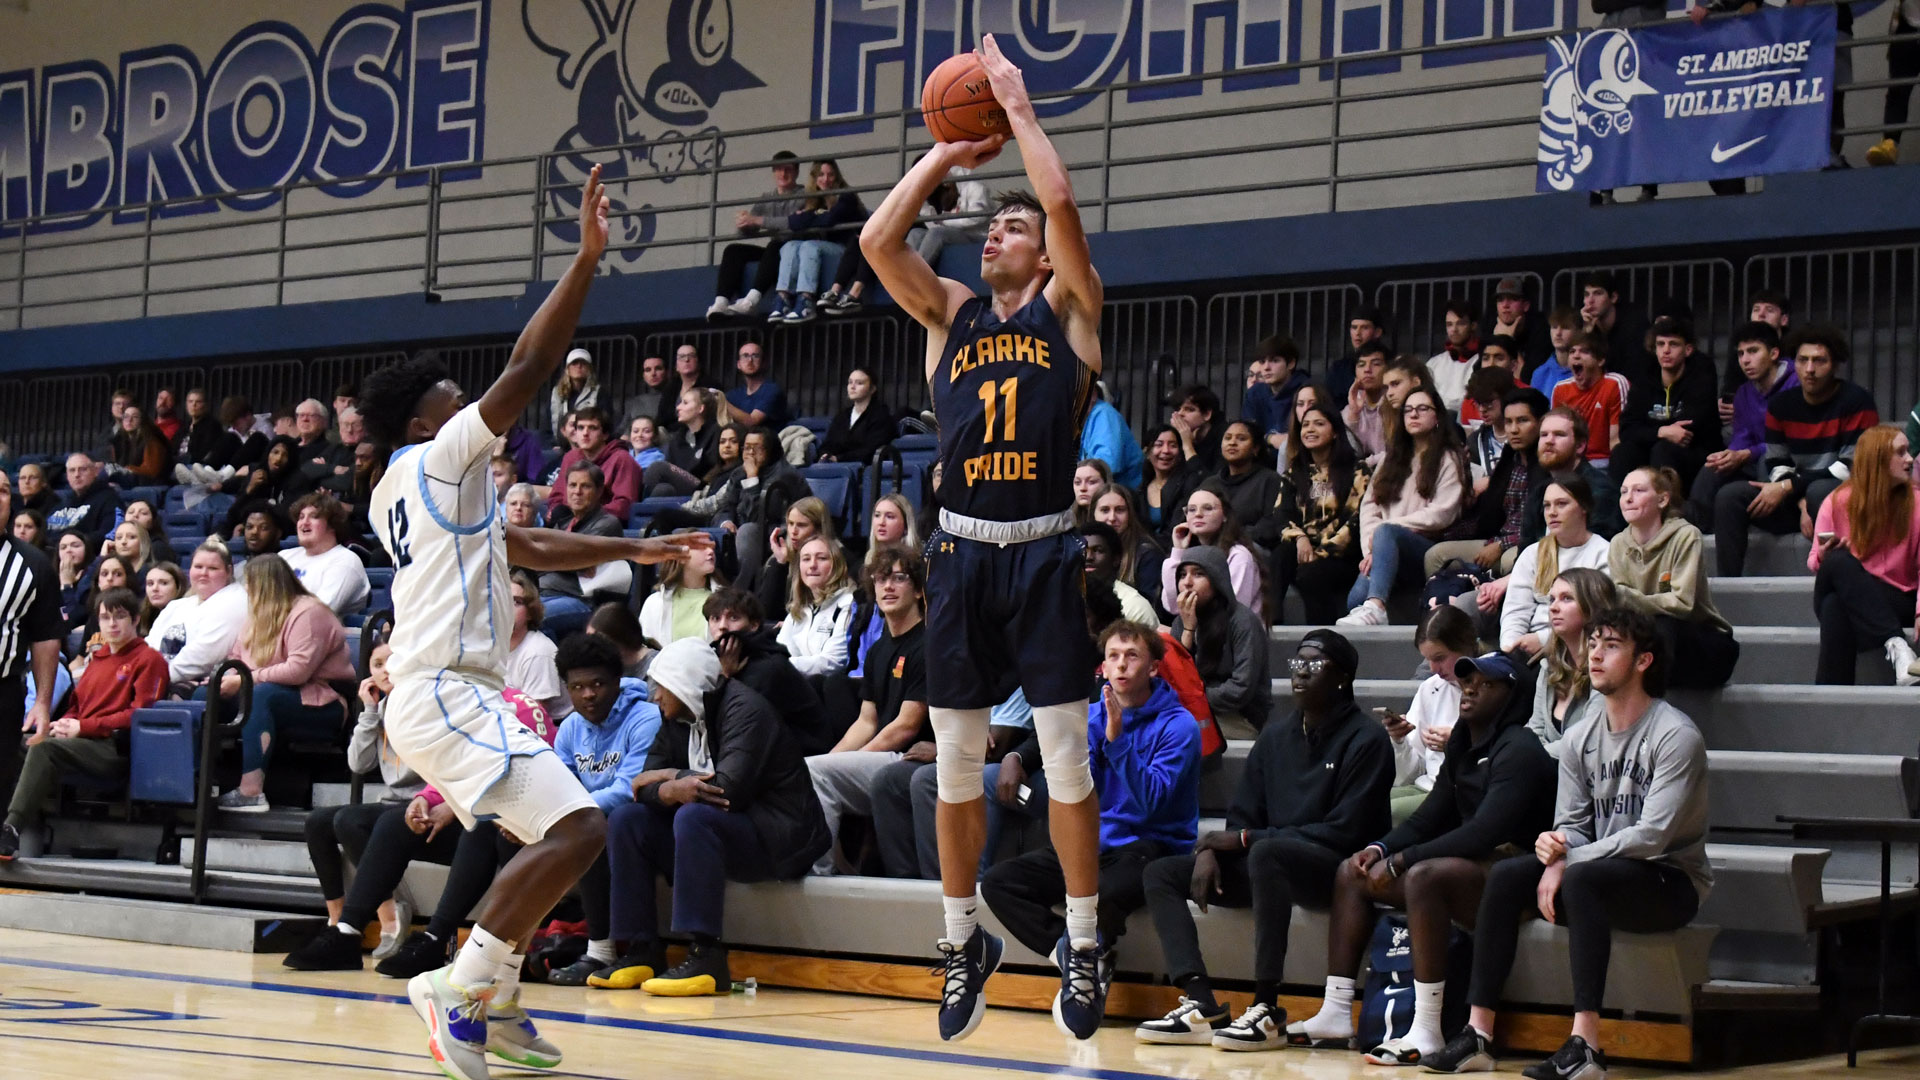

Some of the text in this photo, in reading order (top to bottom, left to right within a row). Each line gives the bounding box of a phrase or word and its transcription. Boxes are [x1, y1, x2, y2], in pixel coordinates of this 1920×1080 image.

[1709, 40, 1812, 73] AMBROSE
[1663, 77, 1825, 119] VOLLEYBALL
[950, 333, 1051, 384] CLARKE
[978, 376, 1018, 444] 11
[963, 451, 1037, 488] PRIDE
